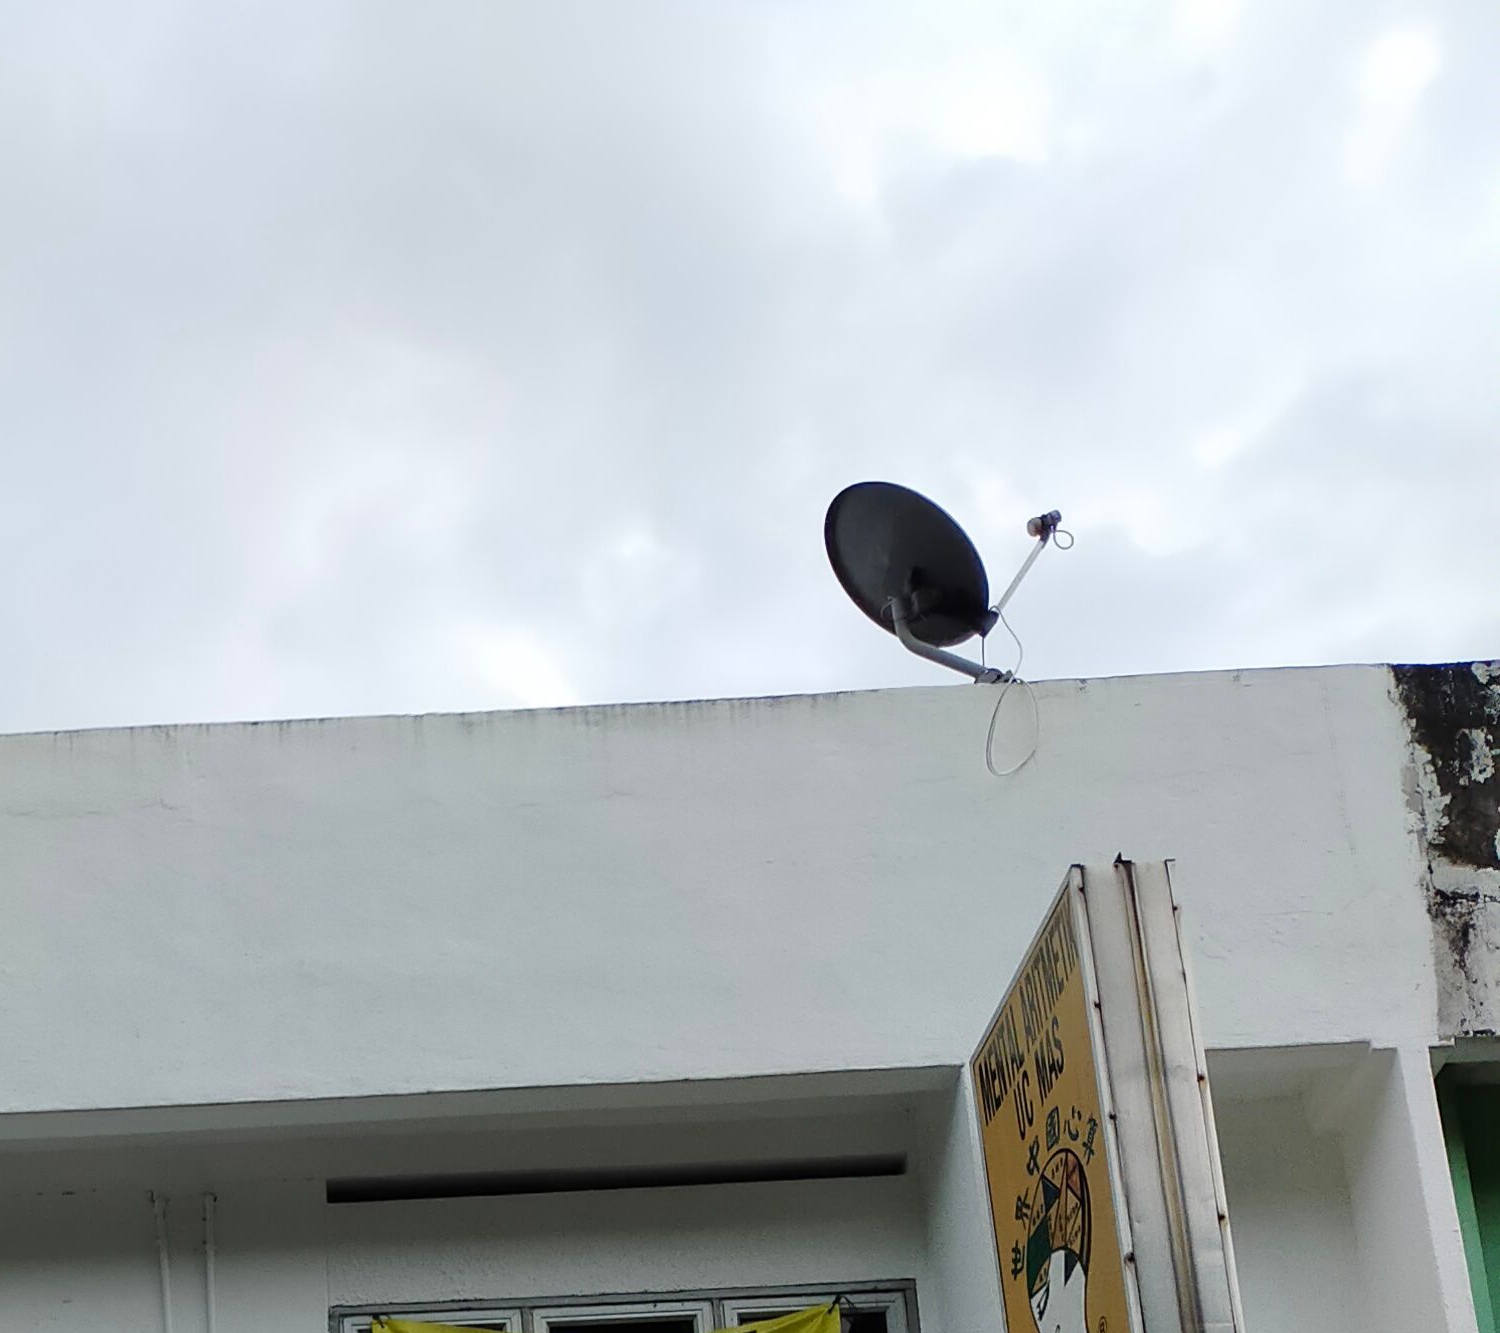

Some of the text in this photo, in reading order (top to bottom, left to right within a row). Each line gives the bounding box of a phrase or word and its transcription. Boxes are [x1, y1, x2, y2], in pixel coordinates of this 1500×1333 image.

[979, 1004, 1024, 1126] MENTAL
[1014, 1016, 1064, 1140] UC MAS
